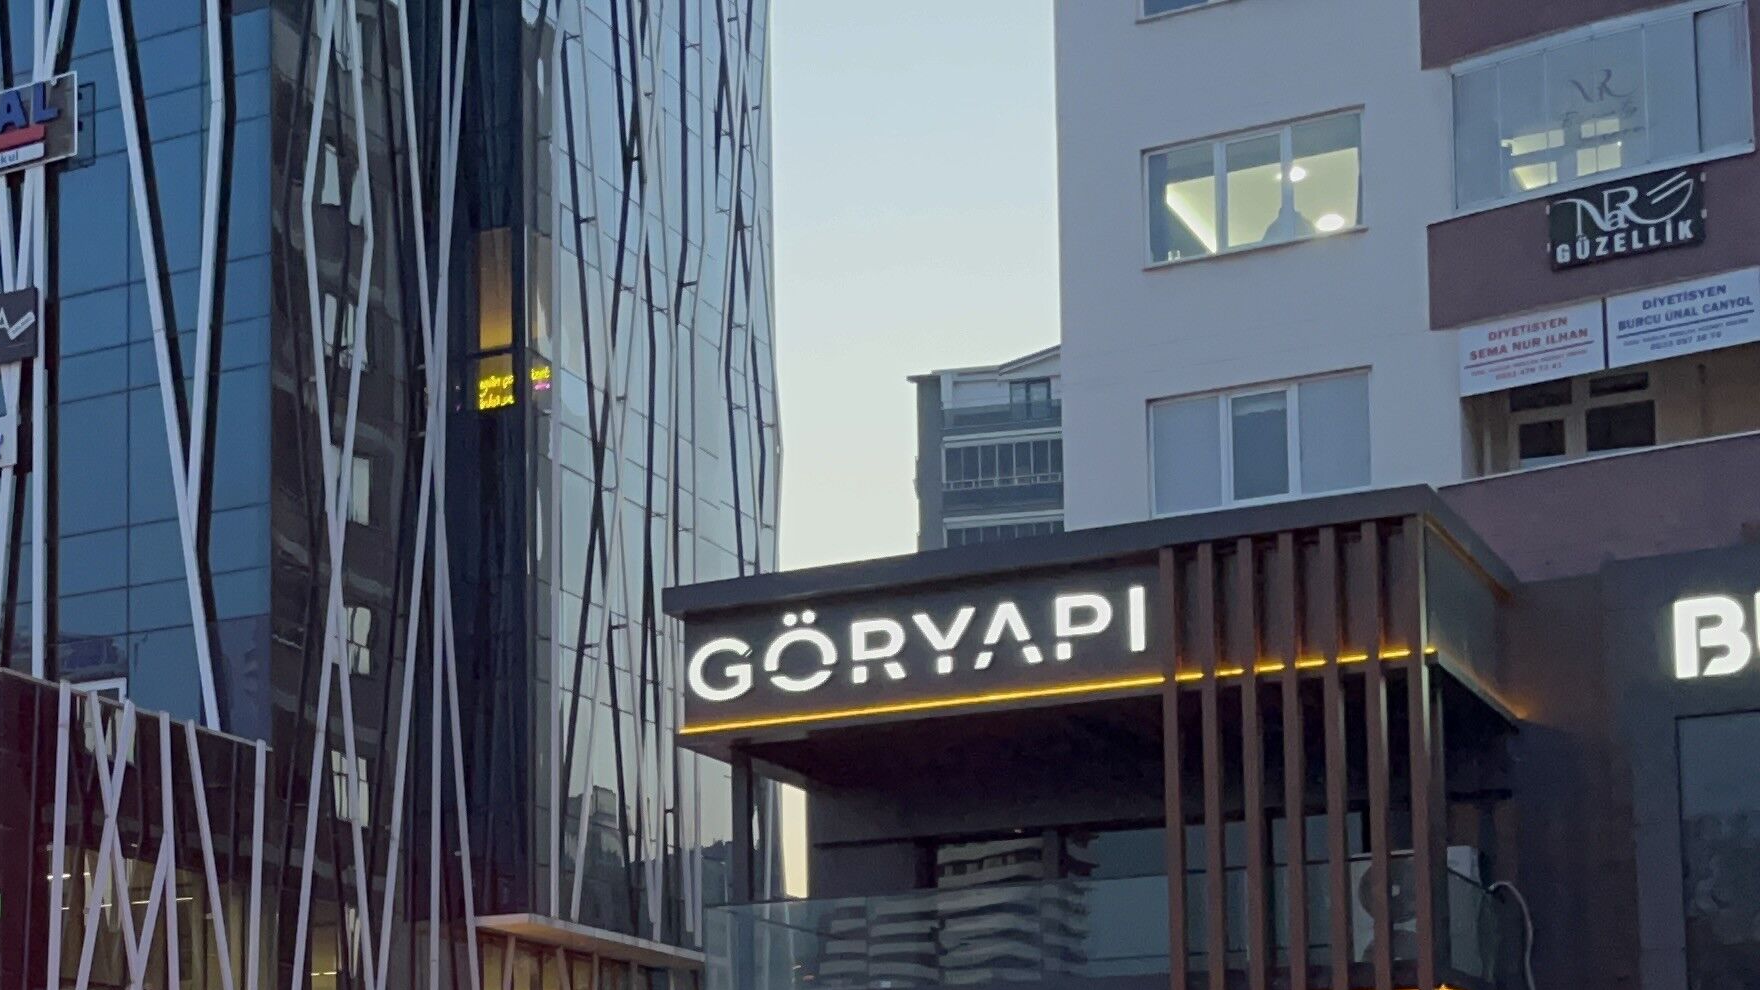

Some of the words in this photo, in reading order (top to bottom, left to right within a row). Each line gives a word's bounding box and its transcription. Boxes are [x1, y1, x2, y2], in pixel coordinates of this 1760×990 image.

[1555, 218, 1695, 265] GÜZELLİK
[1618, 313, 1661, 332] BURCU
[1470, 344, 1508, 361] SEMA
[1512, 336, 1542, 351] NUR
[688, 585, 1146, 701] GÖRYAPI
[1672, 591, 1760, 679] B
